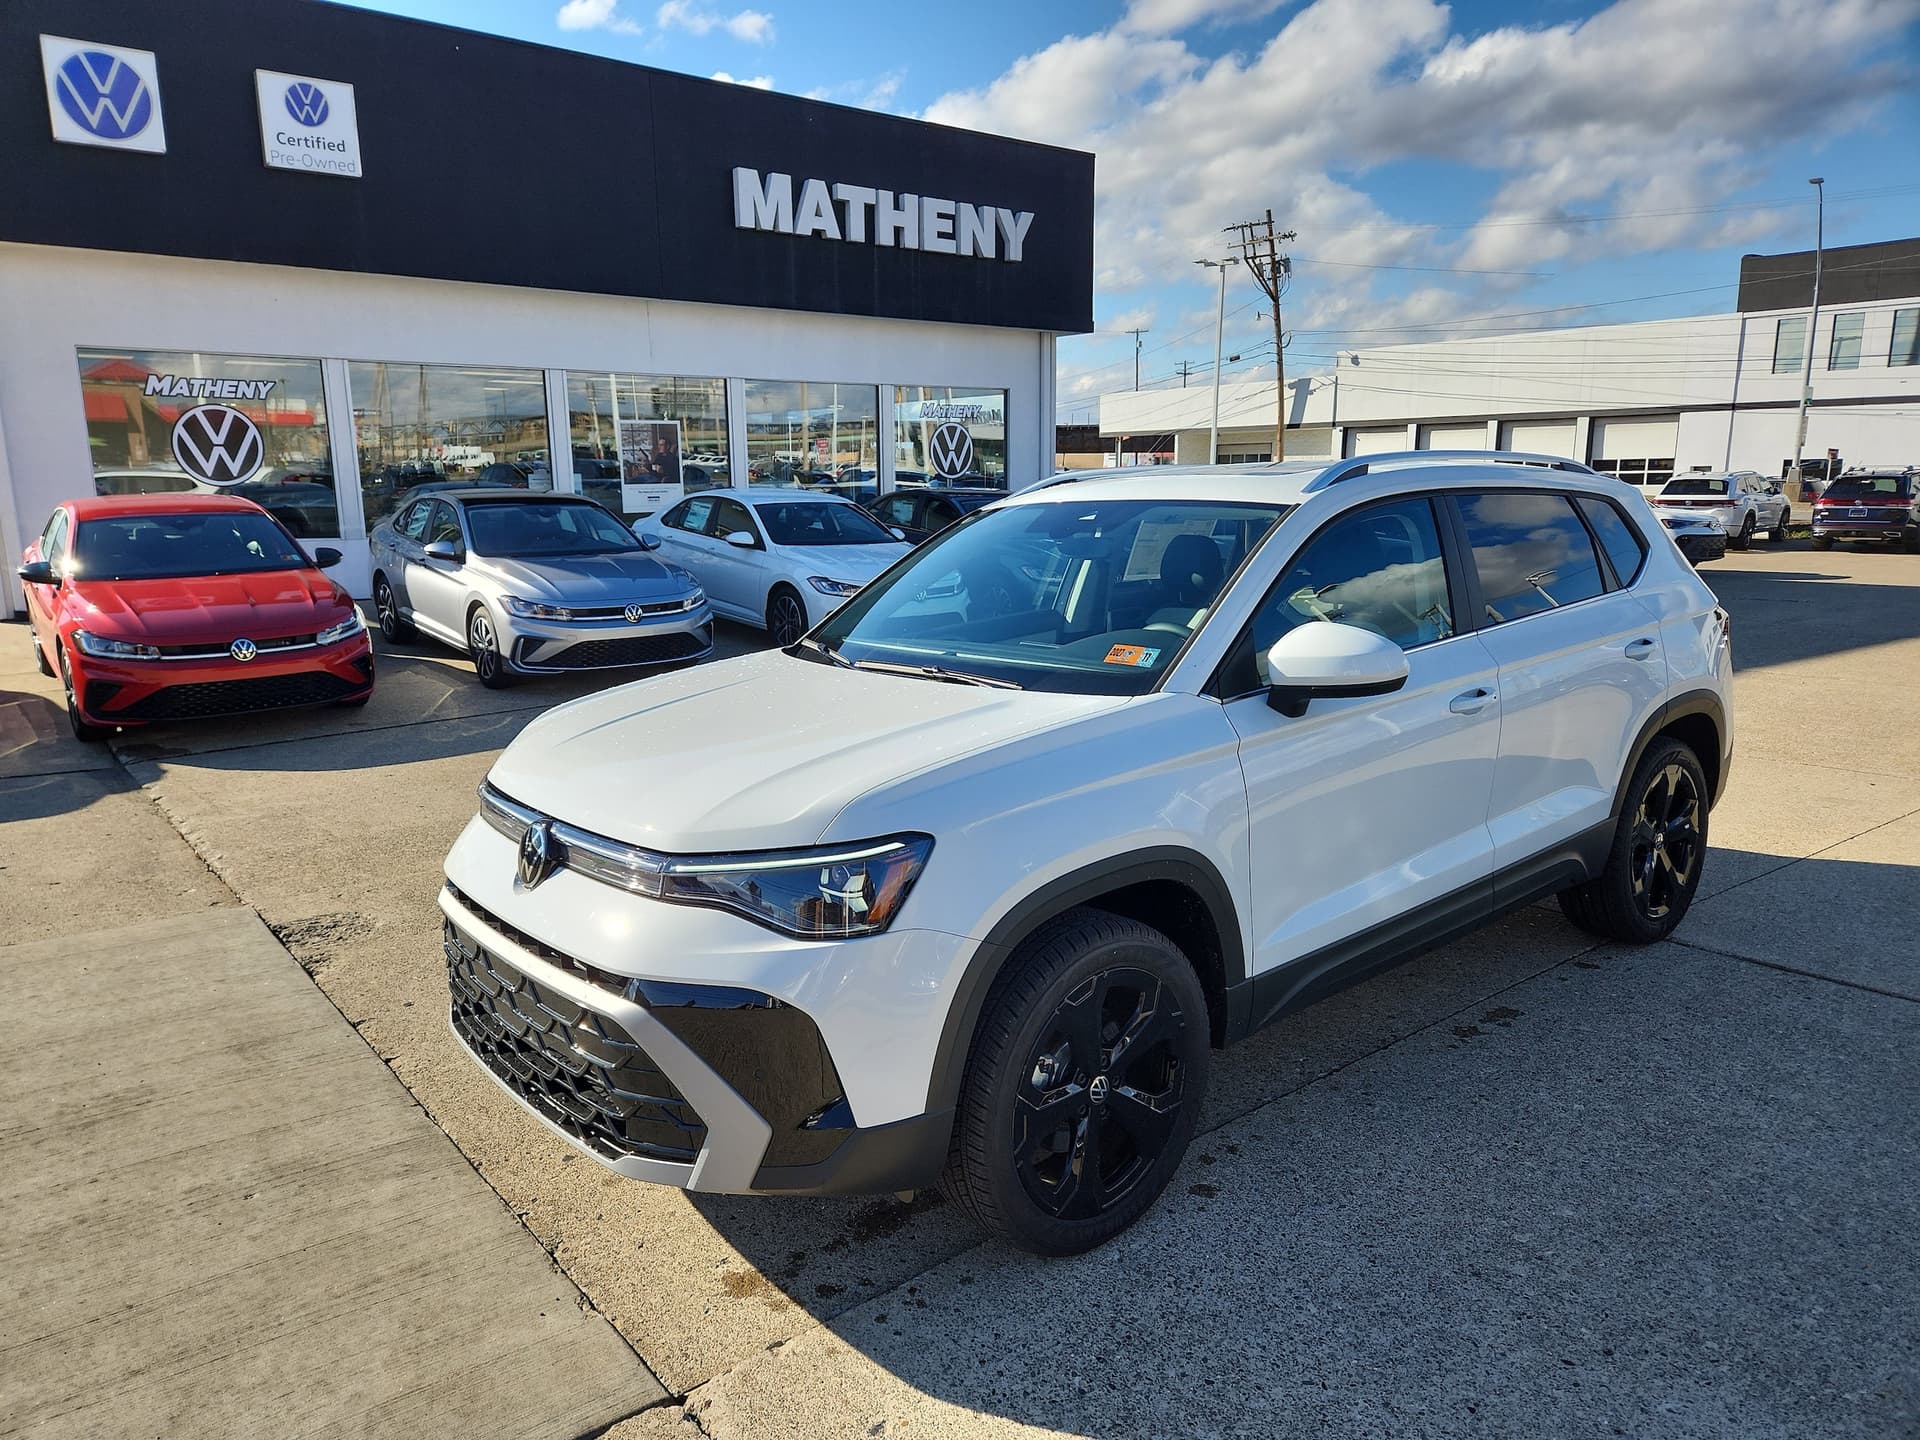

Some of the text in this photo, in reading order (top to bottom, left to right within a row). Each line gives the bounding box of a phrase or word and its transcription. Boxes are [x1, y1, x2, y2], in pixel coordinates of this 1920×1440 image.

[276, 132, 346, 153] Certified
[270, 149, 356, 173] Pre-Owned
[732, 166, 1035, 263] MATHENY
[144, 374, 276, 400] MATHENY
[920, 402, 983, 419] MATHENY
